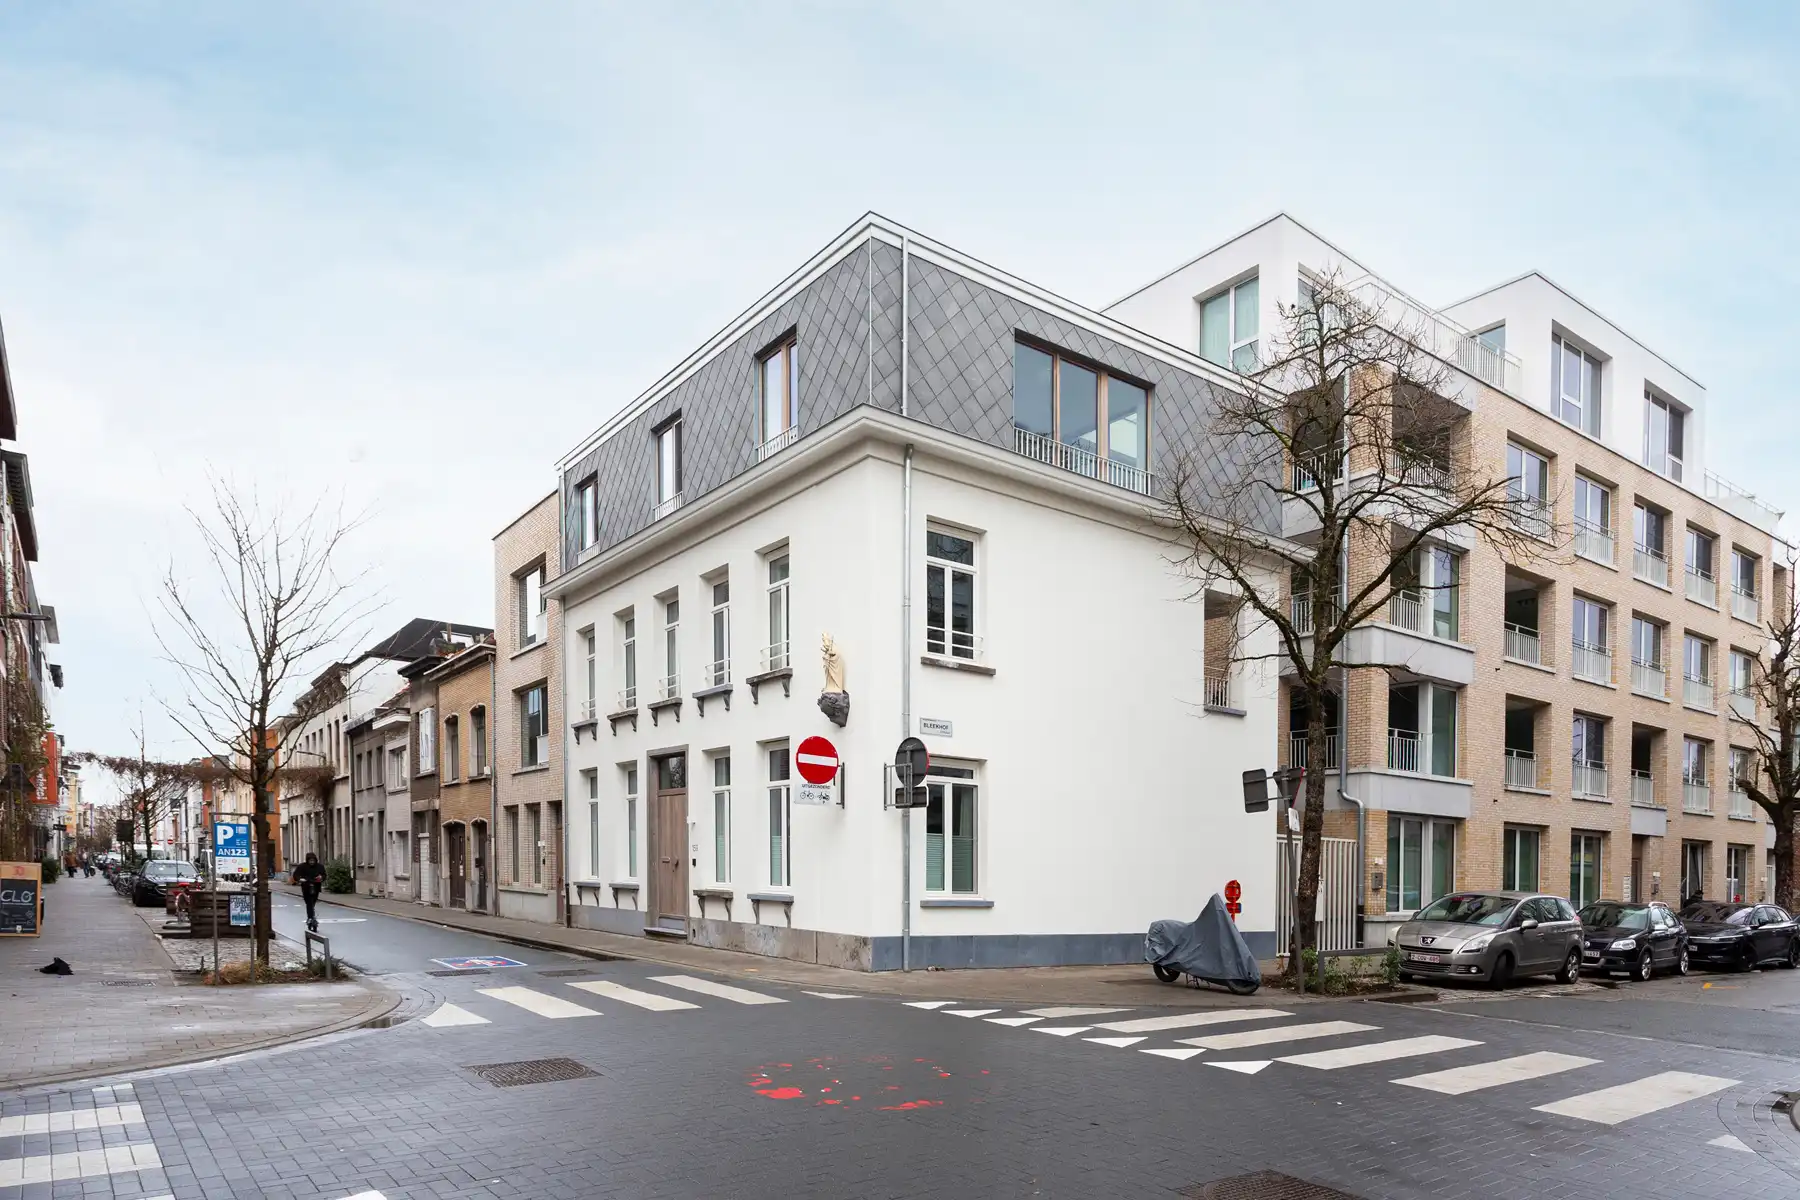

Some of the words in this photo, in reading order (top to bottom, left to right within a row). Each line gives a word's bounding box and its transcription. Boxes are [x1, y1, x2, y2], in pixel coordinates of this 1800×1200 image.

[923, 722, 949, 730] BLEEKHOF
[217, 825, 234, 845] P
[217, 848, 248, 856] AN123
